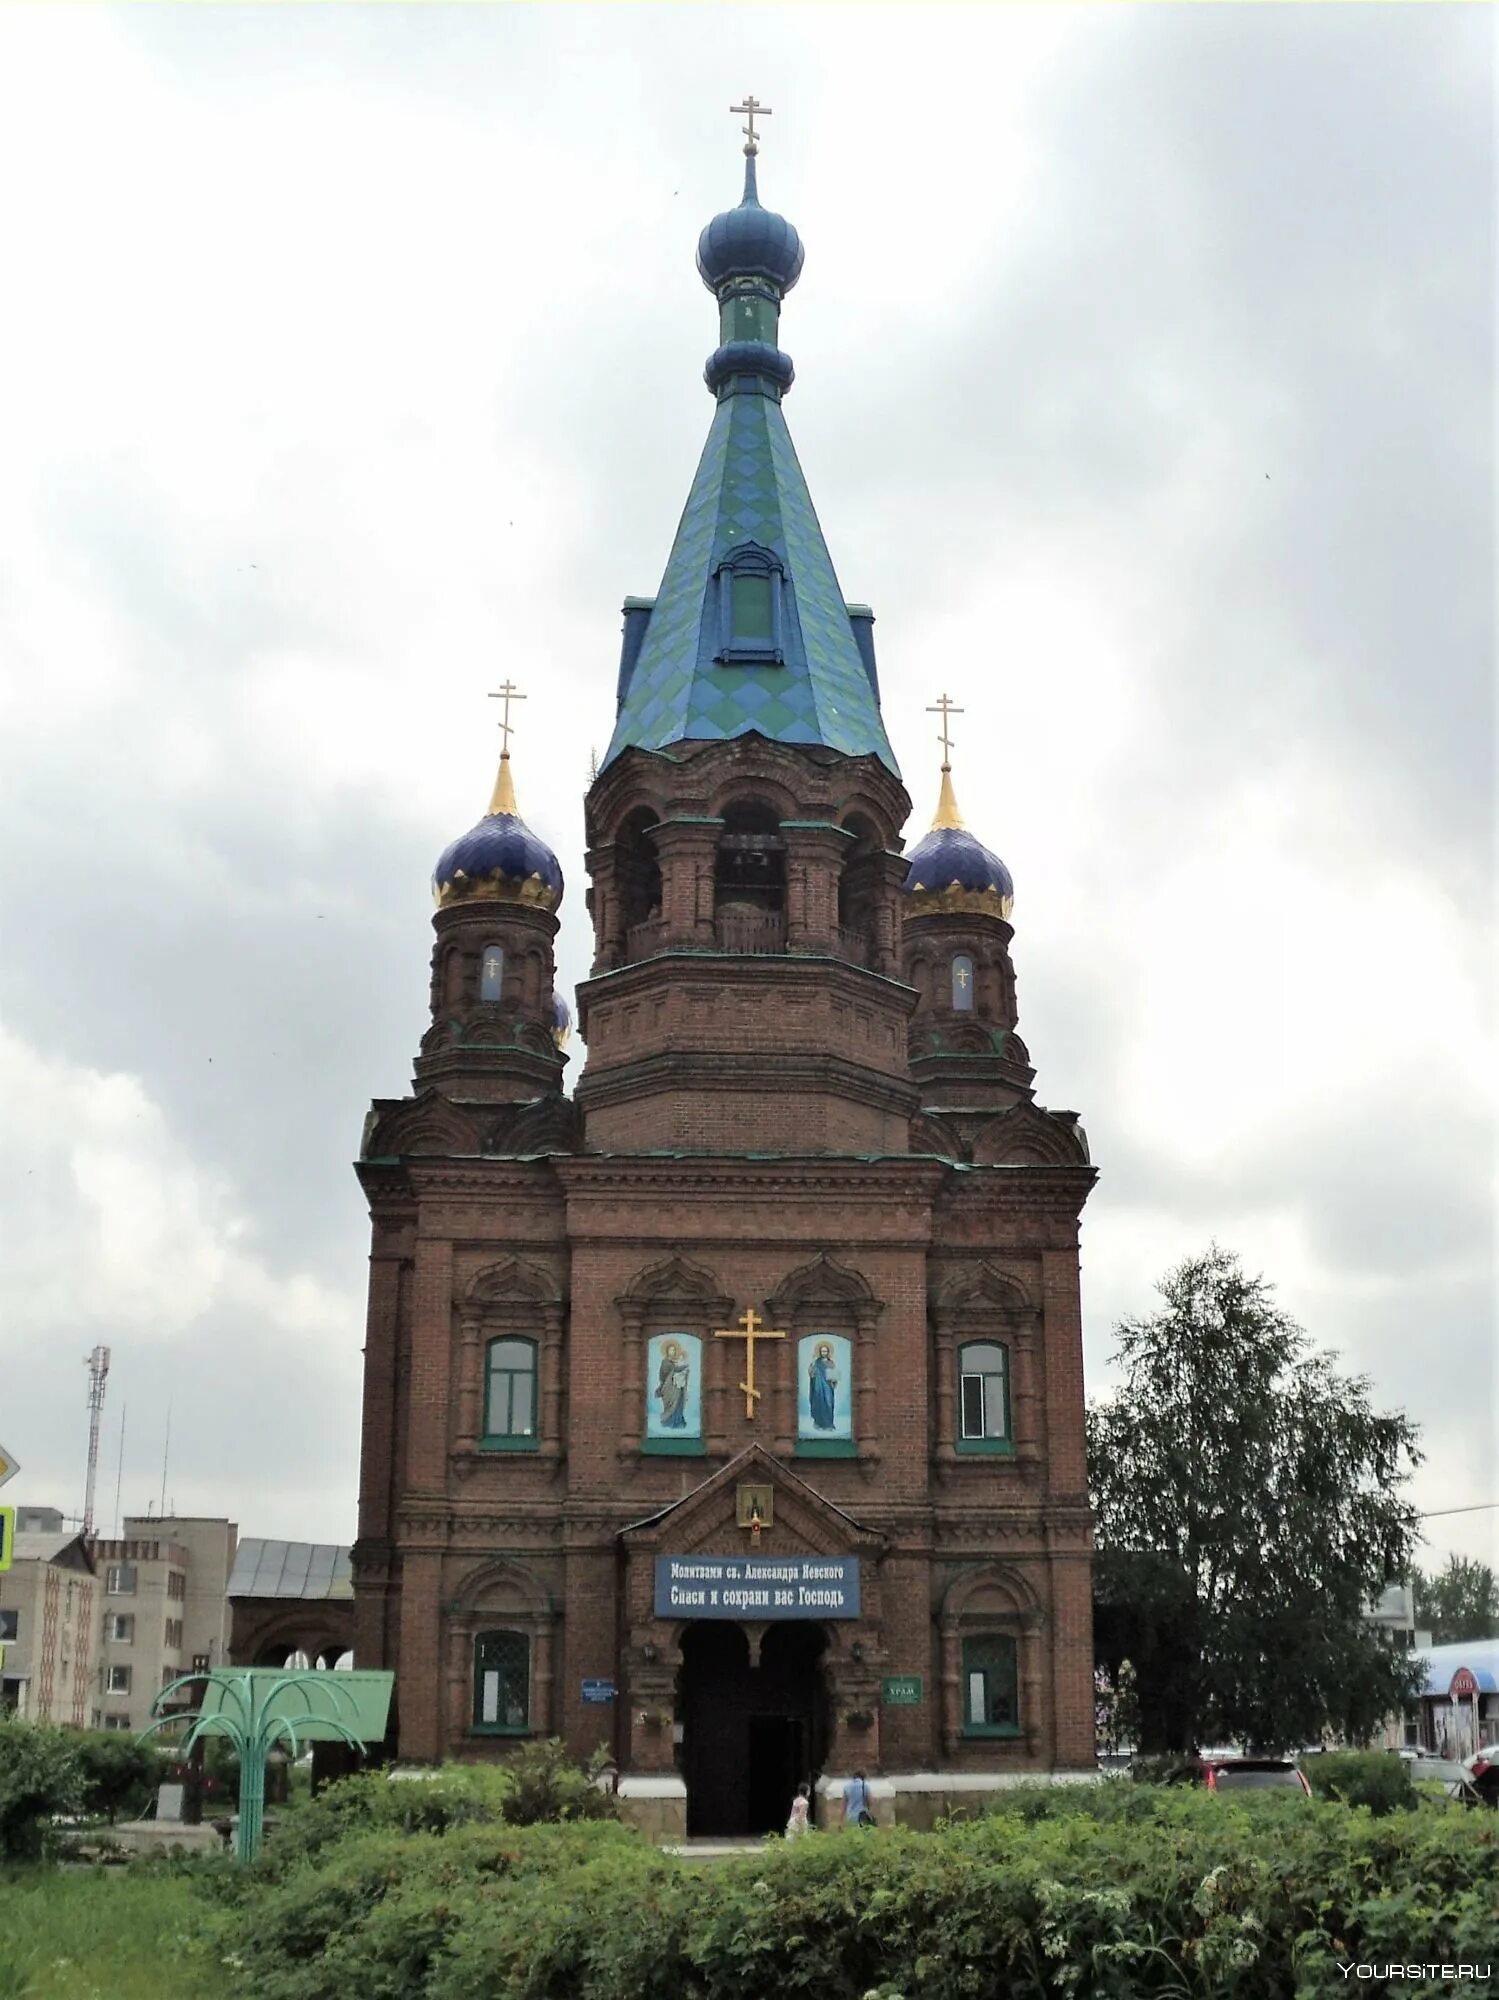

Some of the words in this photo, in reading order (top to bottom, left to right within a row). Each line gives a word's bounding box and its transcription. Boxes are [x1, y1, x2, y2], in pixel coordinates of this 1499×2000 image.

[671, 1563, 722, 1579] Молитвами
[726, 1567, 740, 1579] св.
[745, 1564, 798, 1582] Александра
[803, 1564, 844, 1579] Невского
[671, 1586, 704, 1605] Спаси
[711, 1591, 717, 1605] и
[723, 1591, 768, 1610] сохрани
[775, 1591, 793, 1605] вас
[799, 1587, 844, 1608] Господь
